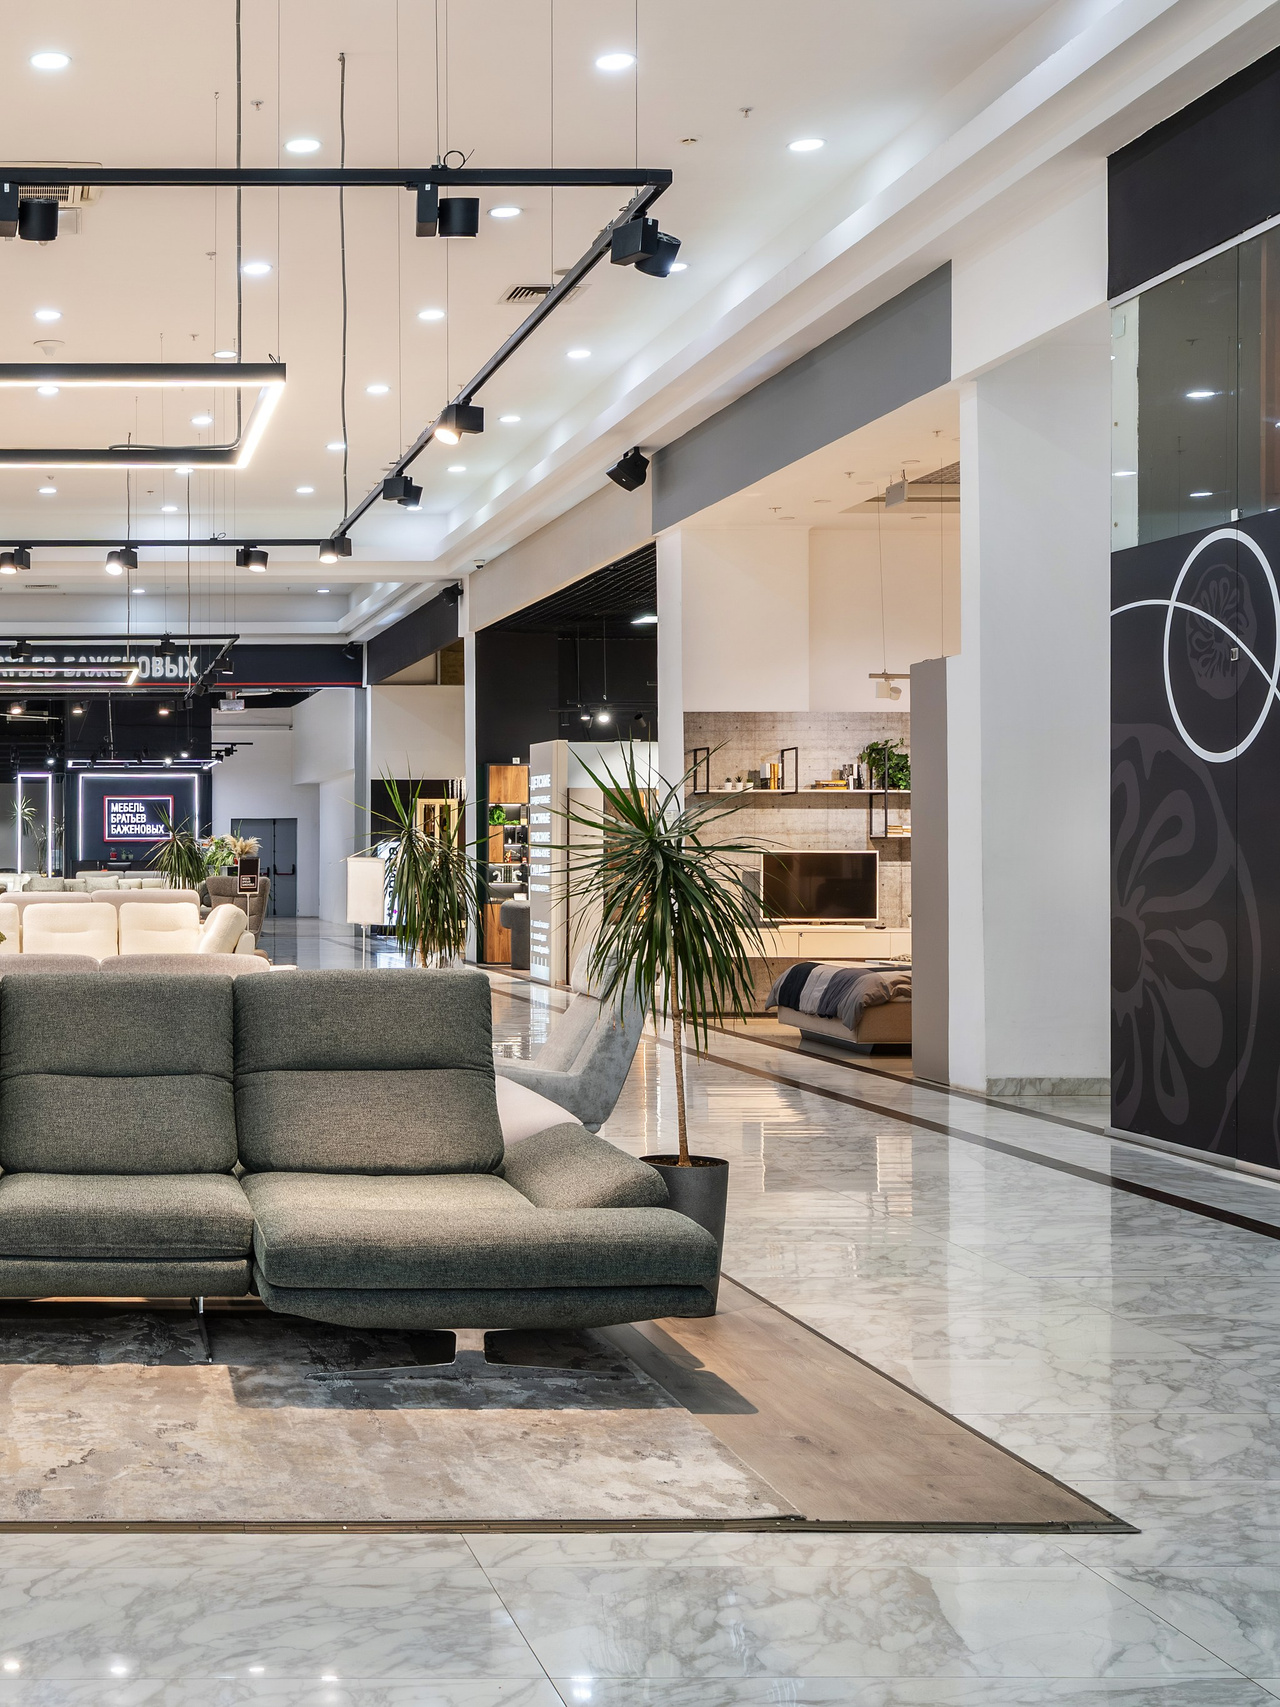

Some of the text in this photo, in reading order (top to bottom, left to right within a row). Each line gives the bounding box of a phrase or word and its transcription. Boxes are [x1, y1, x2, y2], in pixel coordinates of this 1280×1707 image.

[111, 803, 145, 813] МЕБЕЛЬ
[111, 814, 147, 823] БРАТЬЕВ
[111, 825, 165, 834] БАЖЕНОВЫХ
